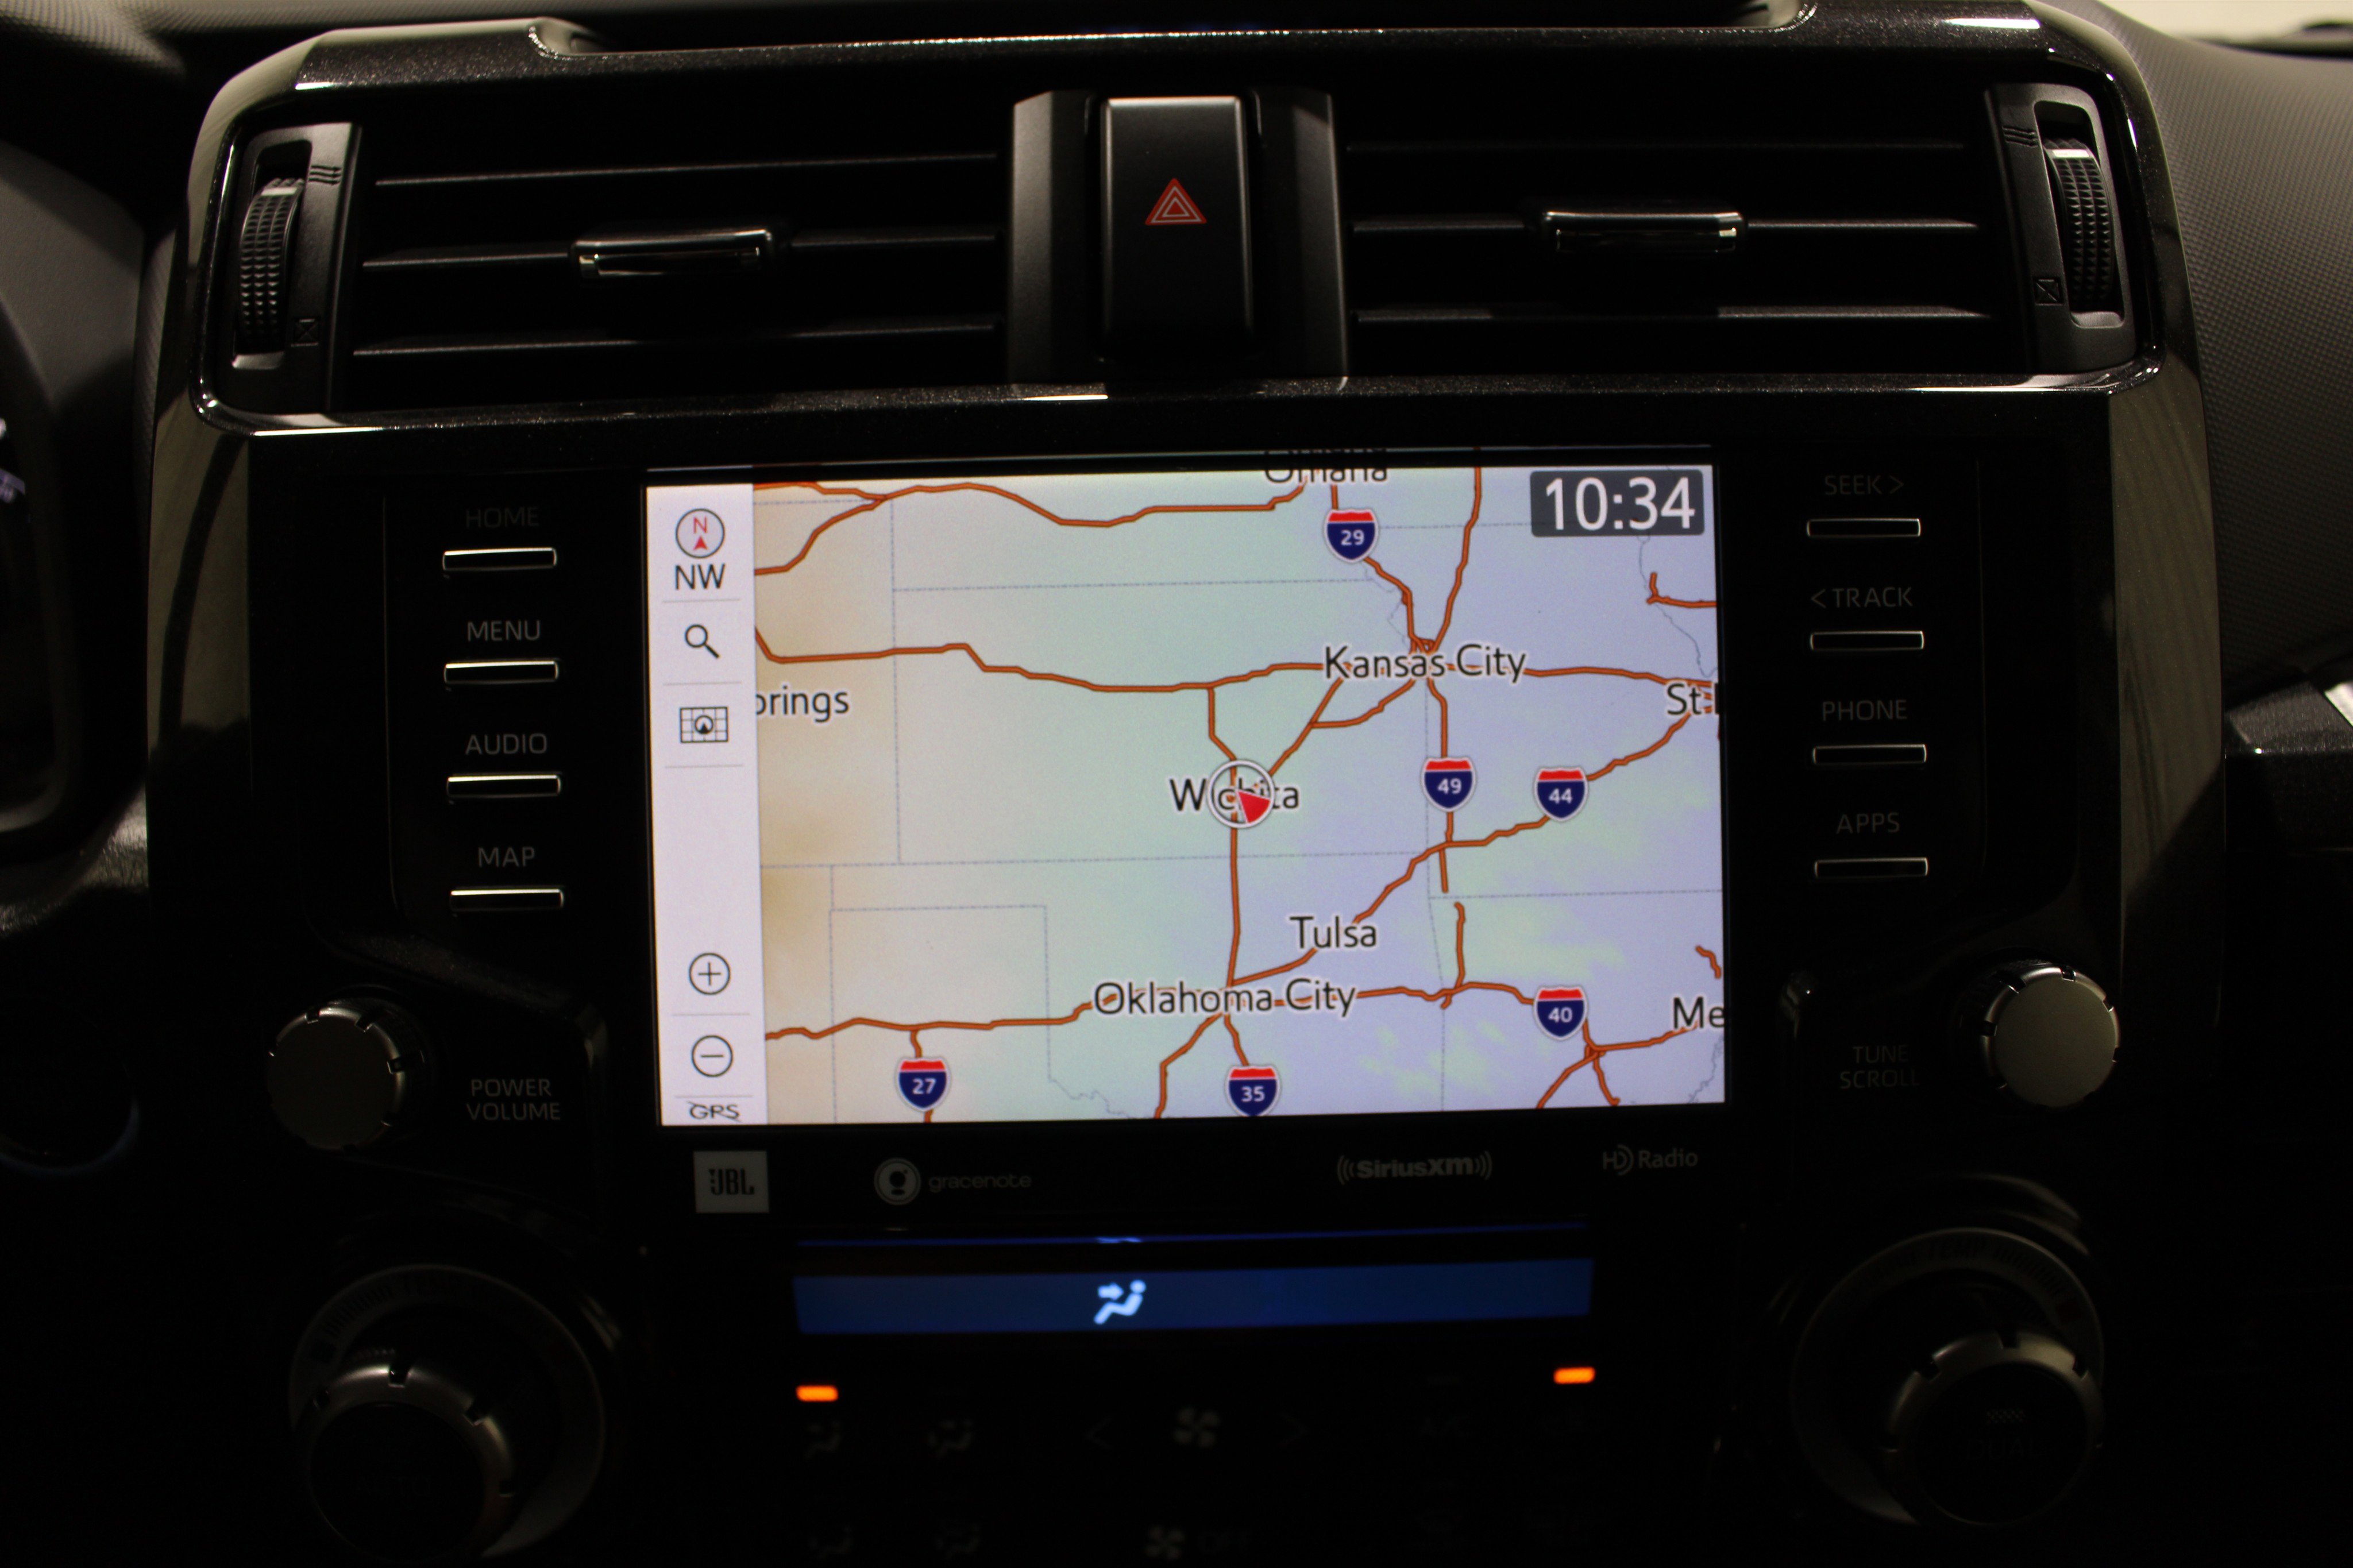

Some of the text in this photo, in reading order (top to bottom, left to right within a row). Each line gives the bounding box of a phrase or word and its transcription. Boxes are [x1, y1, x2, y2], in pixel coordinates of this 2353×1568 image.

[1824, 474, 1883, 496] SEEK
[1545, 476, 1696, 531] 10:34
[465, 506, 540, 528] HOME
[693, 516, 708, 534] N
[1340, 529, 1365, 546] 29
[674, 563, 726, 590] NW
[1831, 586, 1914, 608] TRACK
[466, 619, 541, 642] MENU
[1325, 643, 1527, 683] Kansas City
[1821, 698, 1908, 721] PHONE
[464, 732, 549, 755] AUDIO
[1437, 777, 1463, 795] 49
[1548, 787, 1573, 804] 44
[1835, 811, 1901, 835] APPS
[477, 845, 536, 868] MAP
[1289, 916, 1378, 949] Tulsa
[1094, 977, 1356, 1017] Oklahoma City
[1548, 1006, 1574, 1024] 40
[1673, 996, 1724, 1029] Me
[1851, 1045, 1907, 1064] TUNE
[469, 1077, 552, 1097] POWER
[912, 1077, 937, 1095] 27
[1838, 1069, 1916, 1090] SCROLL
[1241, 1085, 1266, 1103] 35
[465, 1102, 561, 1122] VOLUME
[689, 1104, 741, 1119] GPS
[1637, 1147, 1699, 1169] Radio
[708, 1168, 755, 1196] JBL
[927, 1172, 1033, 1194] gracenote
